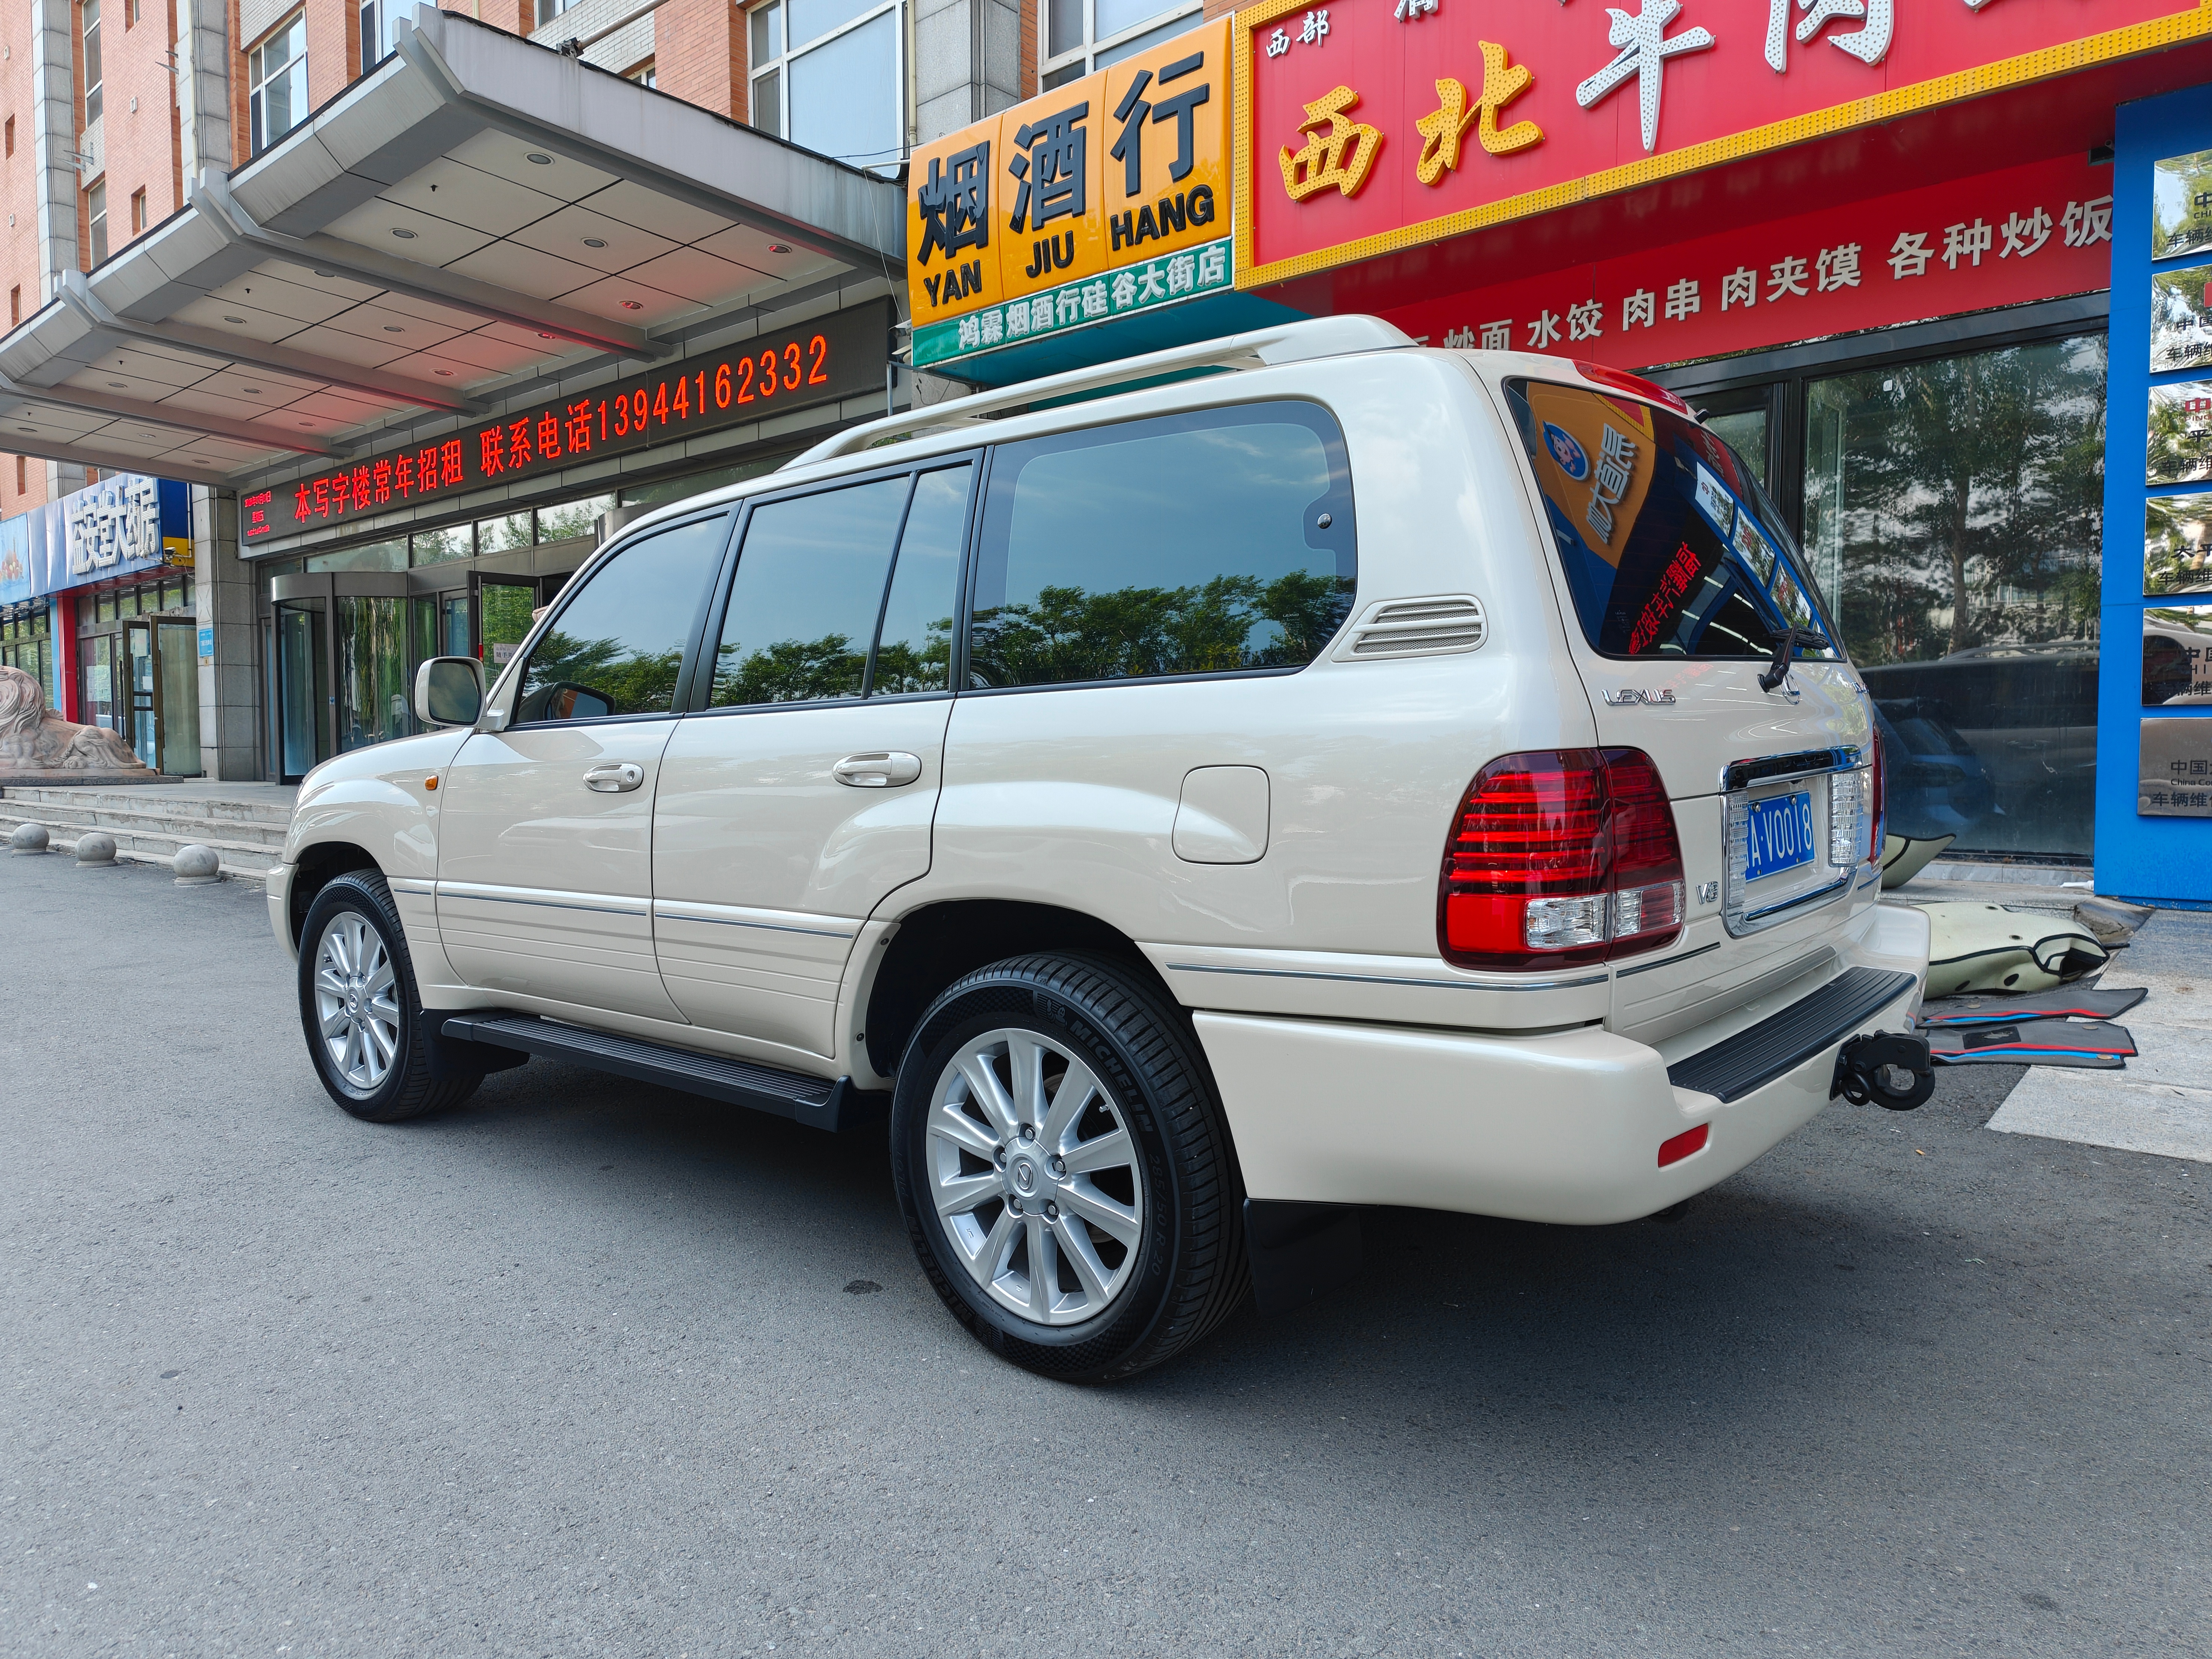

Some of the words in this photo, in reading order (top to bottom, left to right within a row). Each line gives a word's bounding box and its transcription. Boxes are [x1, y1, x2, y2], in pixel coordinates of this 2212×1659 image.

[1266, 9, 1329, 57] 西部
[917, 51, 1210, 266] 烟酒行
[924, 260, 982, 307] YAN
[1026, 230, 1074, 278] JIU
[1110, 184, 1215, 251] HANG
[1527, 299, 1604, 349] 水饺
[1622, 278, 1700, 331] 肉串
[1721, 242, 1862, 312] 肉夹馍
[1887, 195, 2113, 280] 各种炒饭
[958, 245, 1226, 350] 鸿霖烟酒行硅谷大街店
[295, 439, 464, 523] 本写字楼常年招租
[480, 335, 827, 477] 联系电话13944162332
[71, 477, 159, 575] 益安堂大药房
[1600, 688, 1676, 706] LEXUS
[2152, 792, 2212, 807] 车辆维
[2171, 759, 2212, 775] 中国
[1746, 802, 1813, 869] A·V0018
[1695, 881, 1719, 905] V8
[1070, 1020, 1154, 1132] MICHELIN
[1149, 1153, 1167, 1227] 285/50
[1151, 1250, 1163, 1276] 20
